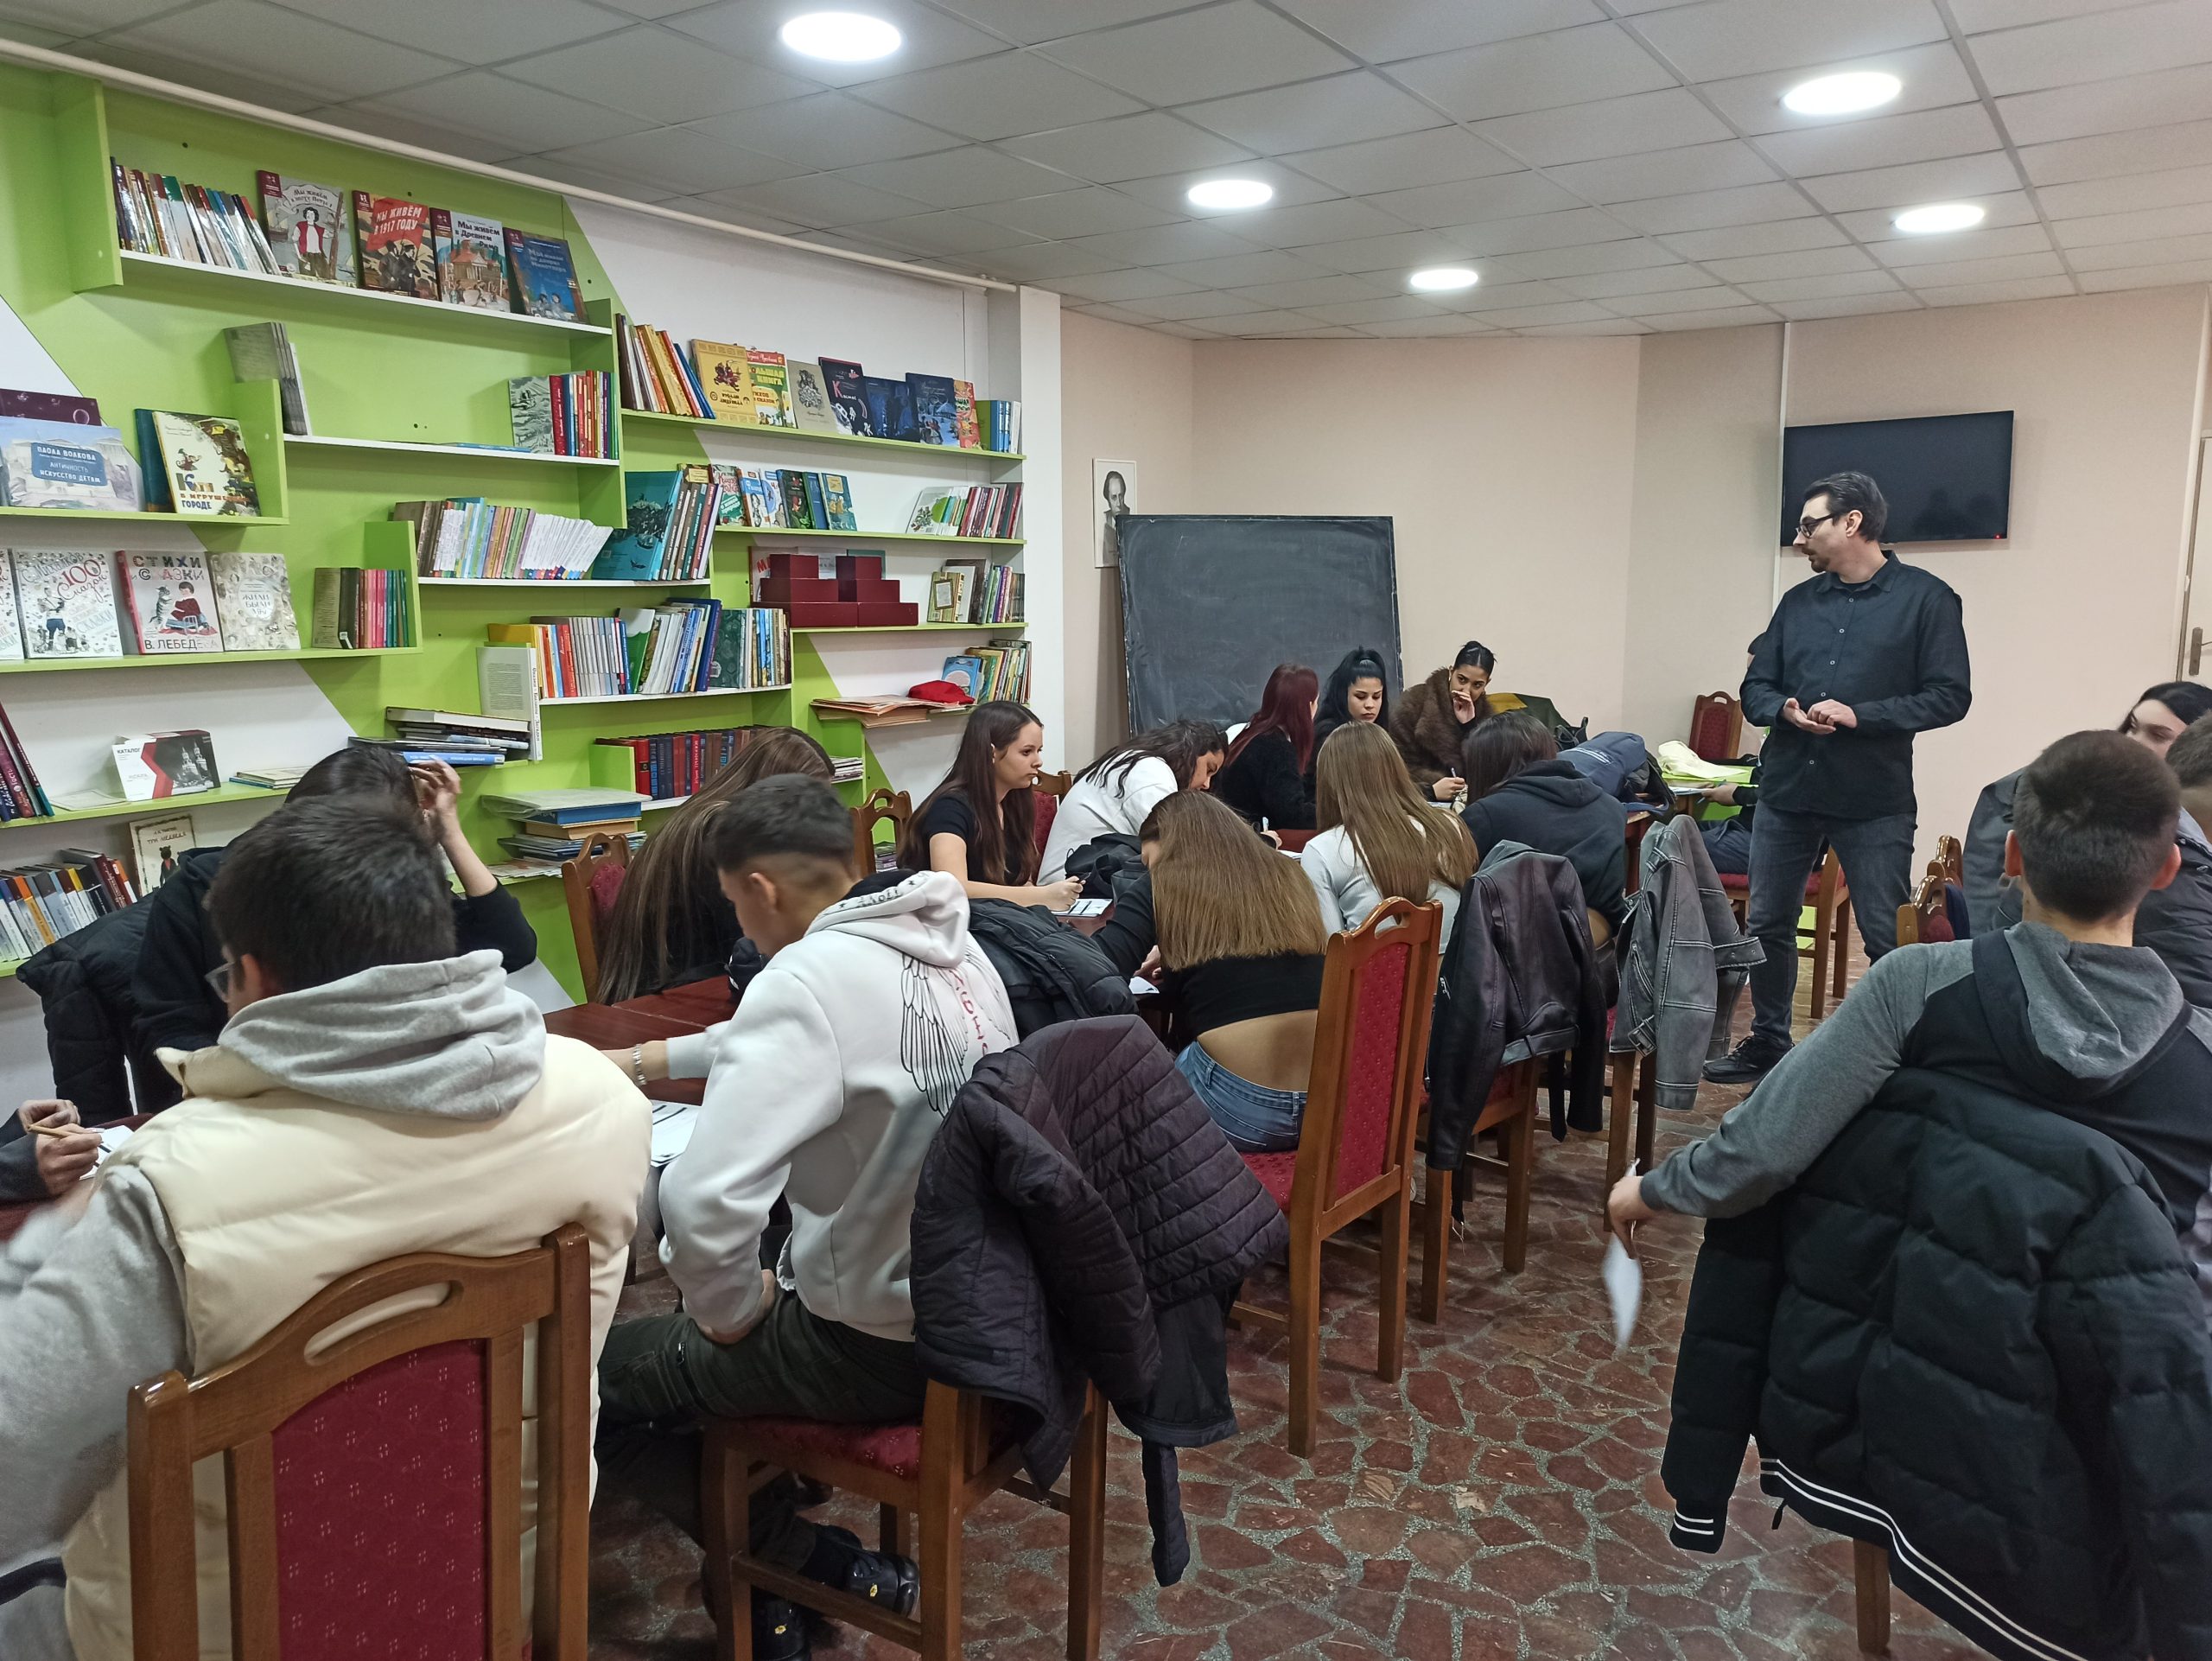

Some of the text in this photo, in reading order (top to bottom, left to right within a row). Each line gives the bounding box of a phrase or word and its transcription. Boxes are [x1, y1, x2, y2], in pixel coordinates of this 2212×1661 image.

[389, 206, 423, 220] ЖИВЁМ
[379, 220, 396, 234] 1917
[396, 218, 418, 232] ГОДУ
[457, 220, 473, 231] Мы
[474, 226, 500, 237] живём
[461, 229, 493, 242] Древнем
[37, 446, 61, 456] ПАОЛА
[63, 450, 97, 461] ВОЛКОВА
[40, 469, 77, 480] ИСКУССТВО
[181, 500, 212, 510] ГОРОДЕ
[132, 555, 202, 568] СТИХИ
[61, 559, 101, 586] 100
[144, 640, 156, 650] В.
